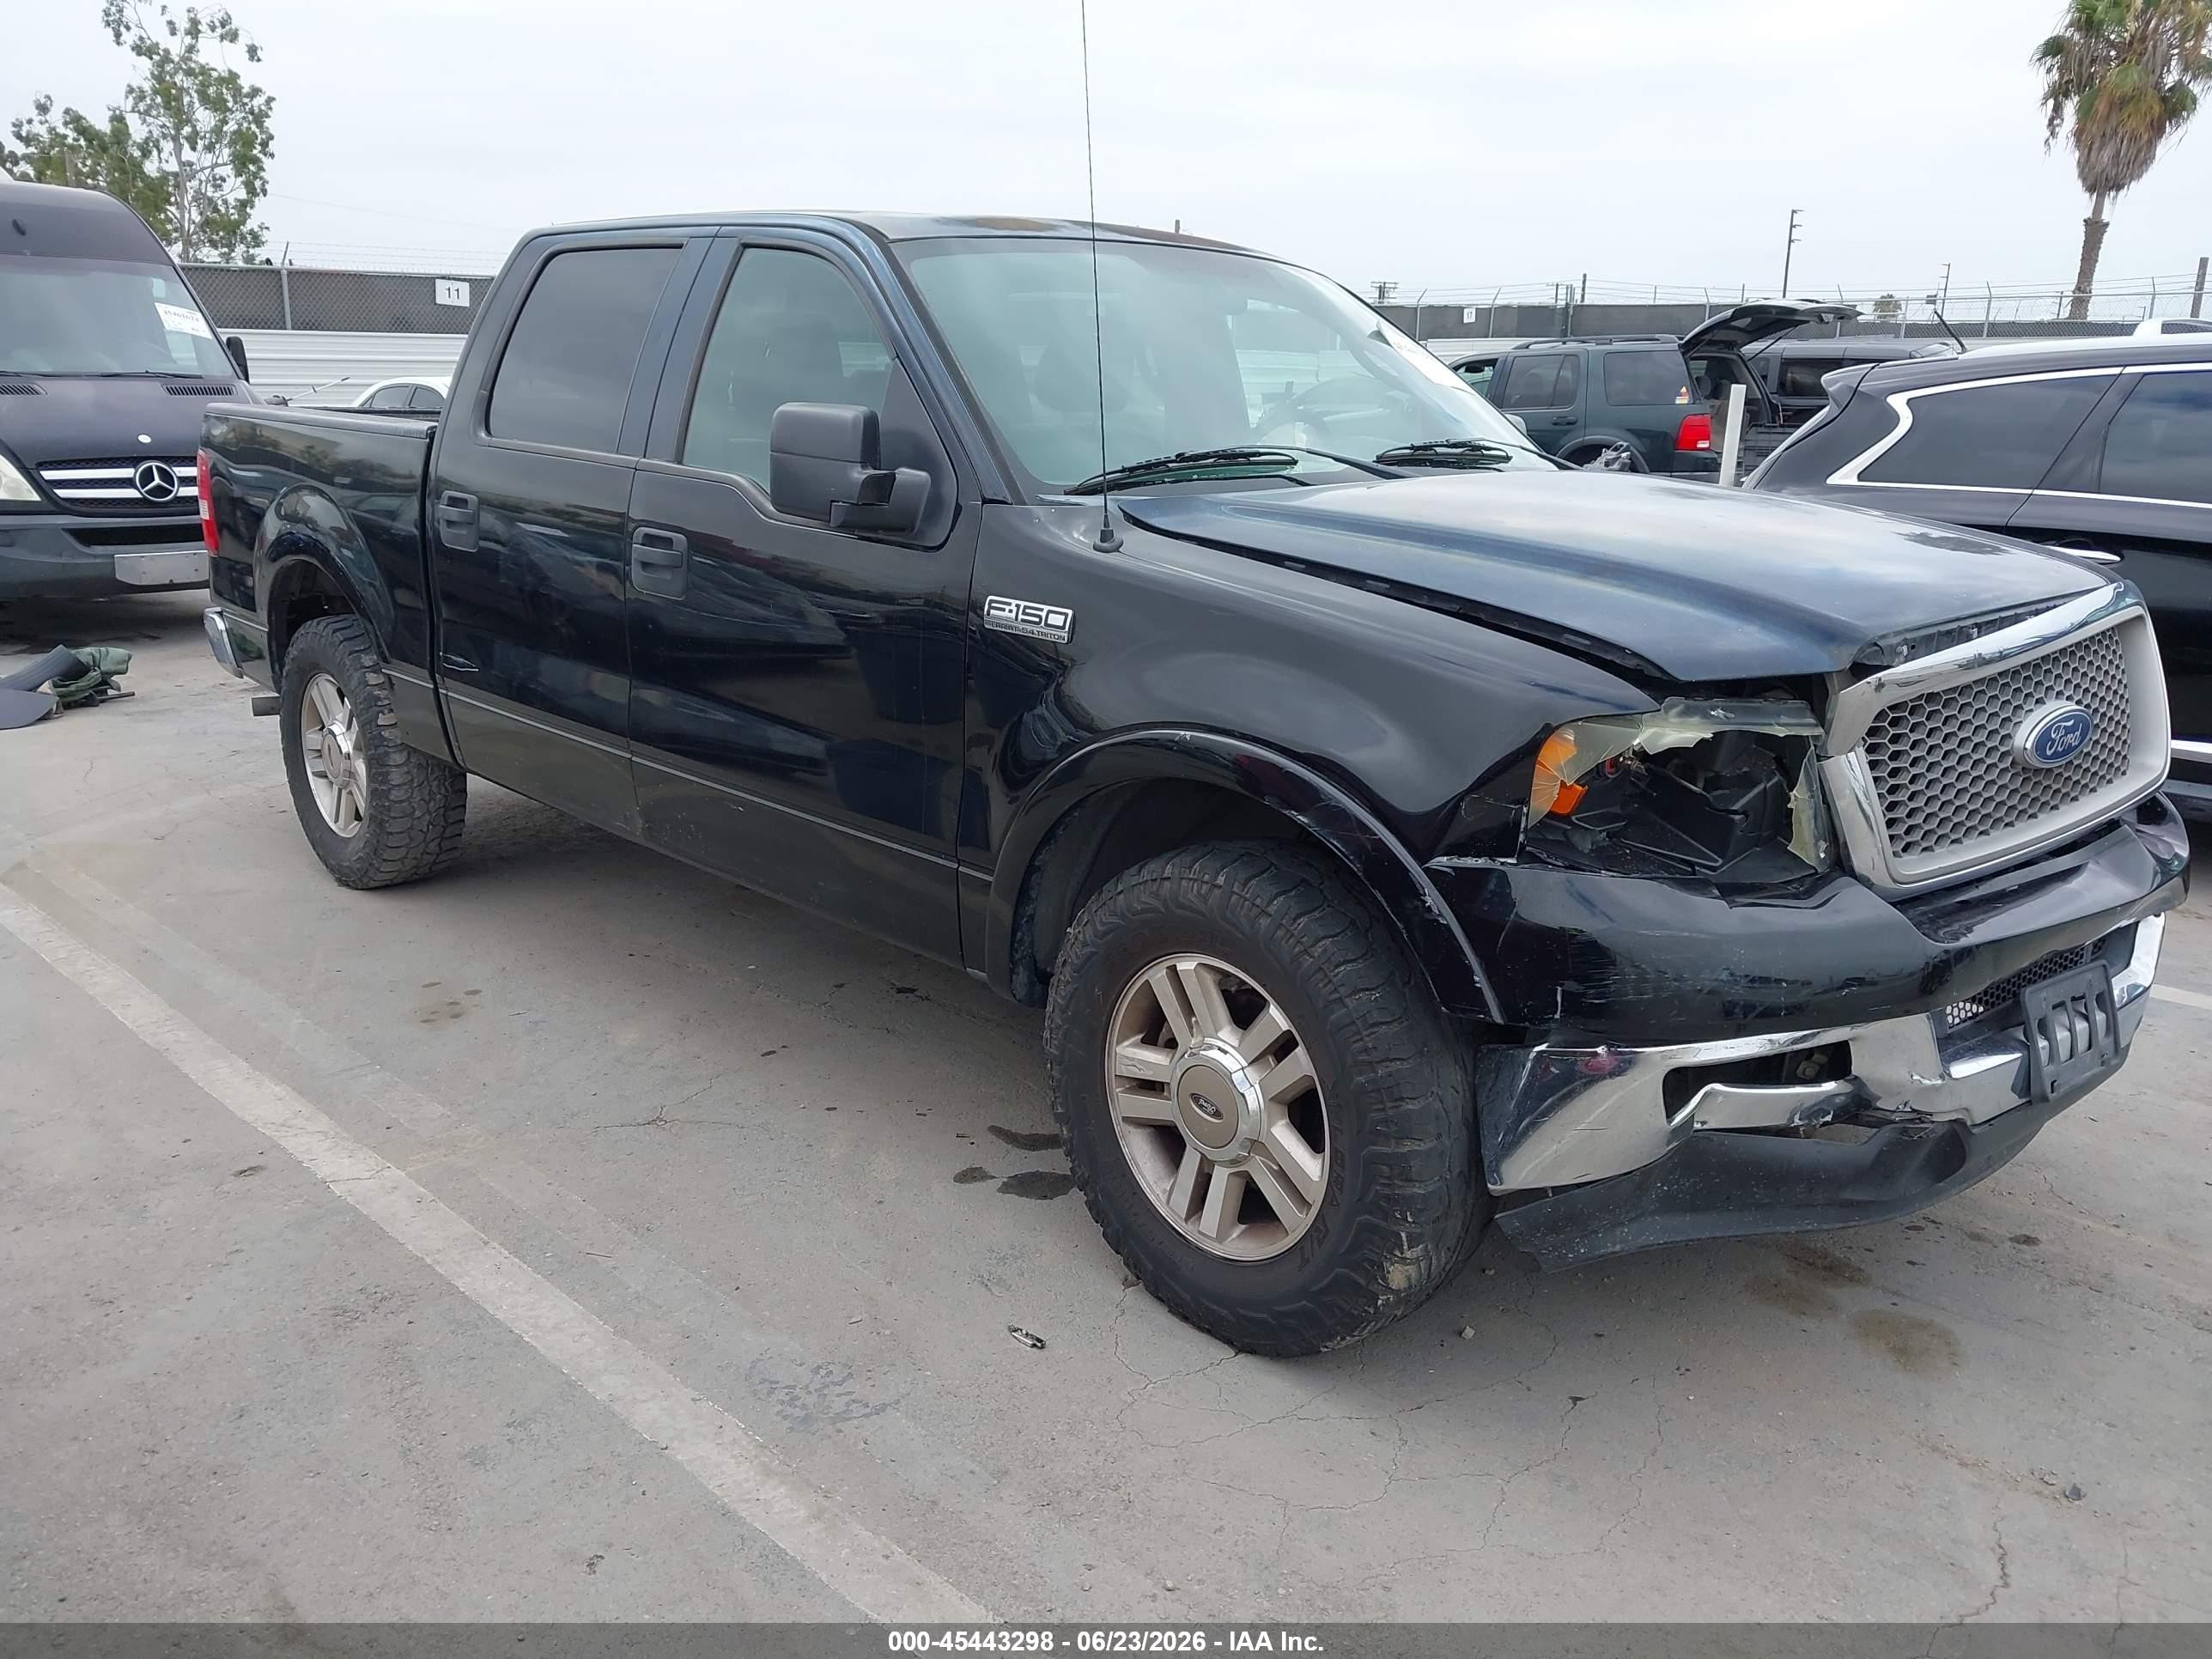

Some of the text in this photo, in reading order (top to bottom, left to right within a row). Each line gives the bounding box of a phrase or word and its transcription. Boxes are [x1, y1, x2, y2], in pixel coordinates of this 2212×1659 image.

[445, 286, 460, 300] 11
[1036, 629, 1066, 641] TRITON
[2045, 719, 2082, 756] Ford
[1198, 1098, 1218, 1115] Ford
